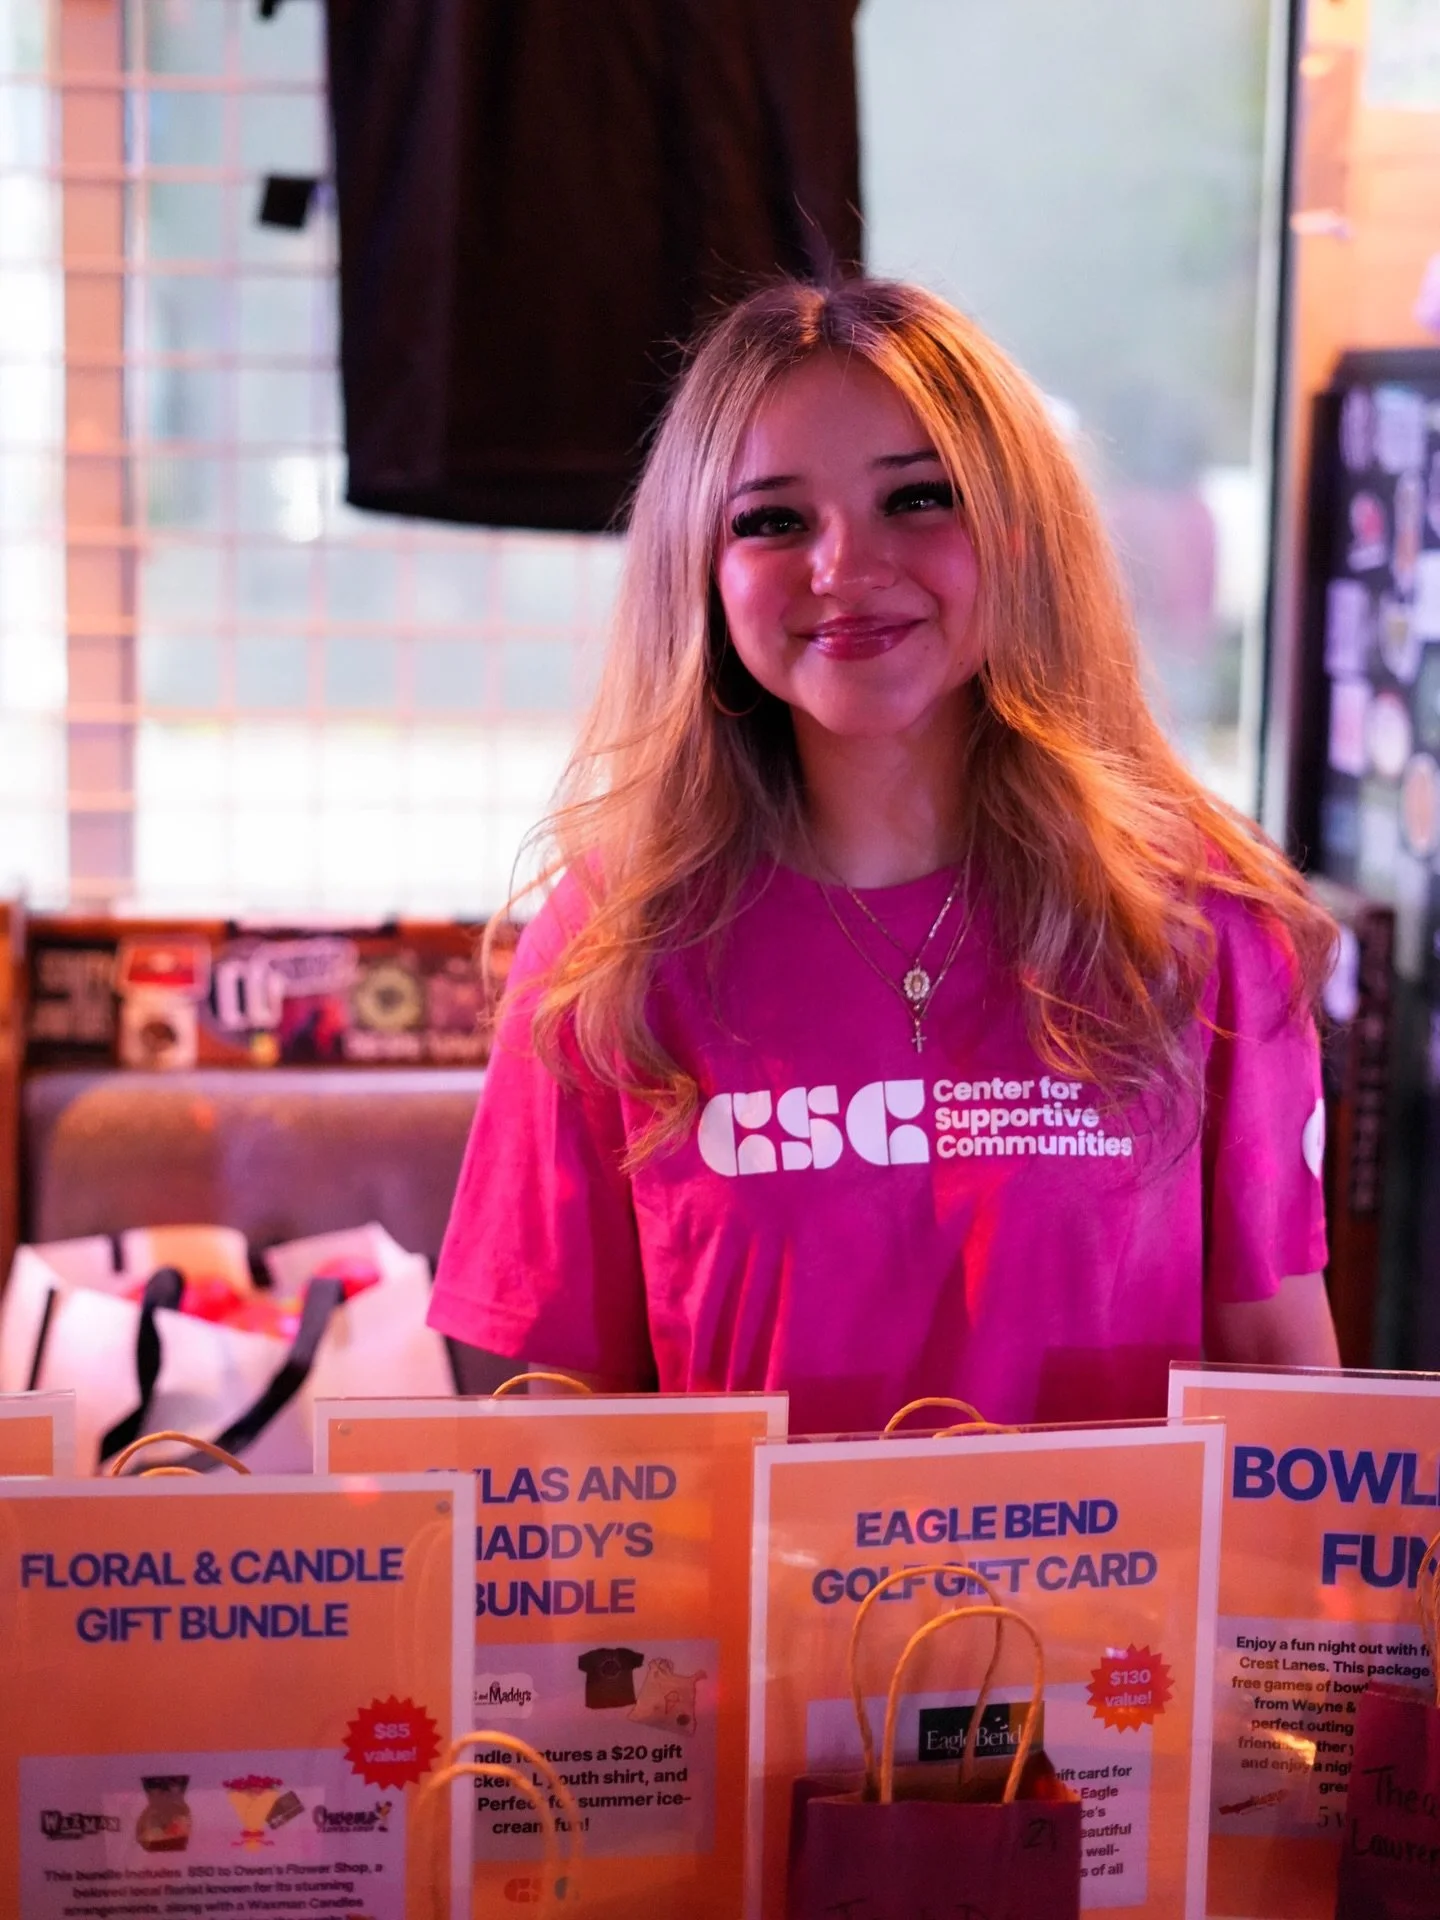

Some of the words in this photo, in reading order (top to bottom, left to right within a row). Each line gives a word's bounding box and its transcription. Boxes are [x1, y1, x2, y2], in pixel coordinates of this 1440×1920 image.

[933, 1077, 1034, 1102] Center
[1039, 1076, 1082, 1100] for
[698, 1079, 930, 1176] CSC
[935, 1102, 1100, 1136] Supportive
[936, 1130, 1133, 1159] Communities
[577, 1465, 677, 1504] AND
[1232, 1446, 1440, 1505] BOWL
[857, 1505, 997, 1548] EAGLE
[1004, 1499, 1118, 1539] BEND
[21, 1551, 185, 1588] FLORAL
[193, 1550, 222, 1586] &
[230, 1547, 405, 1584] CANDLE
[812, 1565, 930, 1605] GOLF
[934, 1558, 1030, 1597] GIFT
[1036, 1551, 1158, 1591] CARD
[76, 1606, 172, 1643] GIFT
[180, 1603, 349, 1641] BUNDLE
[1236, 1636, 1276, 1652] Enjoy
[1280, 1640, 1288, 1650] a
[1291, 1638, 1315, 1651] fun
[1318, 1640, 1357, 1656] night
[1359, 1642, 1382, 1654] out
[1386, 1643, 1417, 1657] with
[1110, 1668, 1151, 1687] $130
[1240, 1656, 1279, 1670] Crest
[1282, 1659, 1329, 1672] Lanes.
[1333, 1661, 1364, 1674] This
[1368, 1662, 1430, 1679] package
[1232, 1676, 1261, 1690] free
[1264, 1679, 1313, 1692] games
[1316, 1679, 1331, 1692] of
[489, 1685, 532, 1707] Maddy's
[1105, 1690, 1152, 1708] value!
[1254, 1697, 1288, 1711] from
[1292, 1699, 1342, 1715] Wayne
[1346, 1702, 1356, 1713] &
[975, 1724, 1022, 1747] Bend
[1251, 1719, 1304, 1732] perfect
[1307, 1721, 1354, 1736] outing
[597, 1750, 607, 1761] a
[611, 1744, 648, 1762] $20
[651, 1744, 683, 1763] gift
[1238, 1736, 1290, 1750] friend
[1316, 1739, 1347, 1753] ther
[363, 1747, 417, 1763] value!
[1078, 1766, 1109, 1780] card
[1112, 1765, 1132, 1777] for
[1241, 1758, 1269, 1769] and
[1272, 1758, 1310, 1773] enjoy
[1313, 1763, 1322, 1772] a
[547, 1770, 599, 1789] outh
[603, 1769, 649, 1785] shirt,
[654, 1768, 688, 1783] and
[478, 1795, 537, 1811] Perfec
[578, 1793, 653, 1808] summer
[657, 1791, 691, 1806] ice-
[1081, 1785, 1119, 1800] Eagle
[1361, 1764, 1440, 1818] Thea
[1080, 1823, 1132, 1838] eautiful
[1086, 1844, 1121, 1857] well-
[286, 1863, 331, 1875] Flower
[334, 1862, 372, 1875] Shop,
[1091, 1864, 1106, 1876] of
[1108, 1863, 1124, 1875] all
[295, 1880, 354, 1893] stunning
